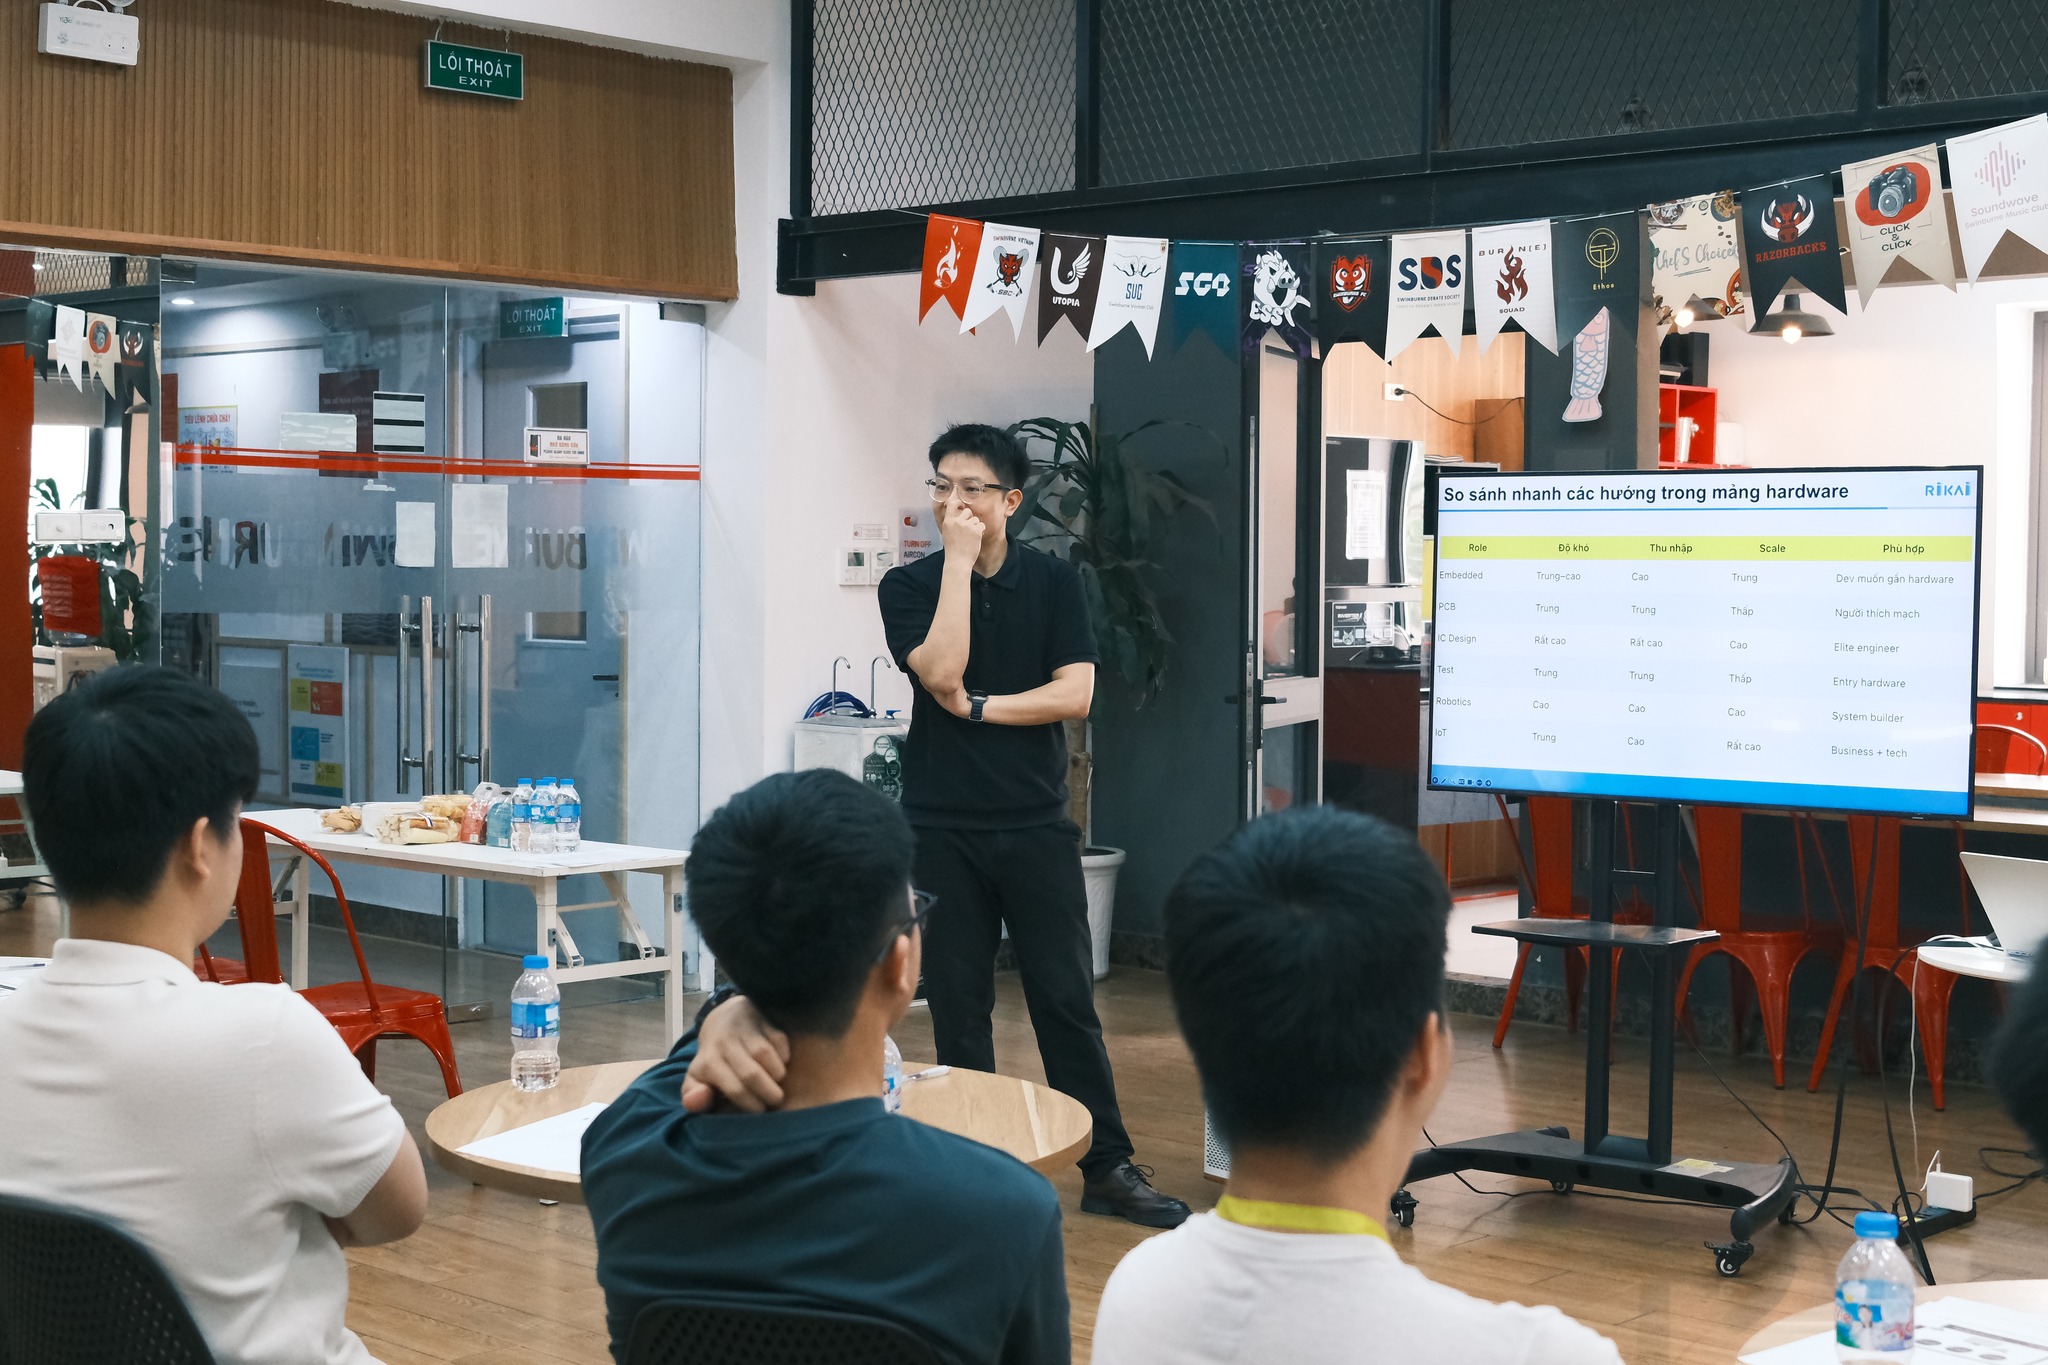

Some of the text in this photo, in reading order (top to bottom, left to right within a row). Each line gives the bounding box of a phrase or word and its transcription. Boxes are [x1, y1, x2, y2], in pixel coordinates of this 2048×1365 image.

[440, 51, 512, 78] LỐI THOÁT
[459, 76, 492, 88] EXIT
[1971, 194, 2038, 216] Soundwave
[1965, 215, 2004, 229] Swinburne
[2006, 208, 2029, 218] Music
[1880, 223, 1910, 236] CLICK
[1018, 237, 1034, 246] VIETNAM
[1892, 234, 1900, 242] &
[1882, 239, 1912, 252] CLICK
[1756, 242, 1826, 262] RAZORBACKS
[1398, 254, 1462, 291] SDS
[1126, 283, 1142, 300] SUC
[1052, 296, 1080, 307] UTOPIA
[524, 304, 556, 321] THOÁT
[520, 325, 542, 333] EXIT
[1444, 484, 1848, 503] So sánh nhanh các hướng trong mảng hardware
[904, 540, 932, 548] TURN OFF
[1559, 543, 1589, 554] Độ khó
[1650, 544, 1692, 554] Thu nhập
[1760, 544, 1785, 552] Scale
[1883, 544, 1924, 555] Phù hợp
[1440, 571, 1483, 579] Embedded
[1537, 572, 1581, 582] Trung-cao
[1632, 572, 1649, 581] Cao
[1732, 573, 1757, 584] Trung
[1836, 574, 1854, 583] Dev
[1909, 575, 1954, 583] hardware
[1439, 602, 1455, 610] PCB
[1536, 604, 1559, 614] Trung
[1631, 605, 1656, 615] Trung
[1835, 609, 1919, 620] Người thích mạch
[1438, 634, 1476, 644] IC Design
[1730, 641, 1747, 649] Cao
[1834, 643, 1899, 654] Elite engineer
[1437, 665, 1453, 673] Test
[1534, 668, 1557, 678] Trung
[1629, 671, 1654, 682] Trung
[1834, 677, 1906, 688] Entry hardware
[1436, 697, 1471, 706] Robotics
[1533, 701, 1549, 709] Cao
[1629, 704, 1645, 712] Cao
[1728, 708, 1745, 716] Cao
[1832, 712, 1904, 722] System builder
[1533, 733, 1556, 743] Trung
[1628, 737, 1644, 745] Cao
[1832, 746, 1873, 756] Business
[1887, 749, 1907, 757] tech
